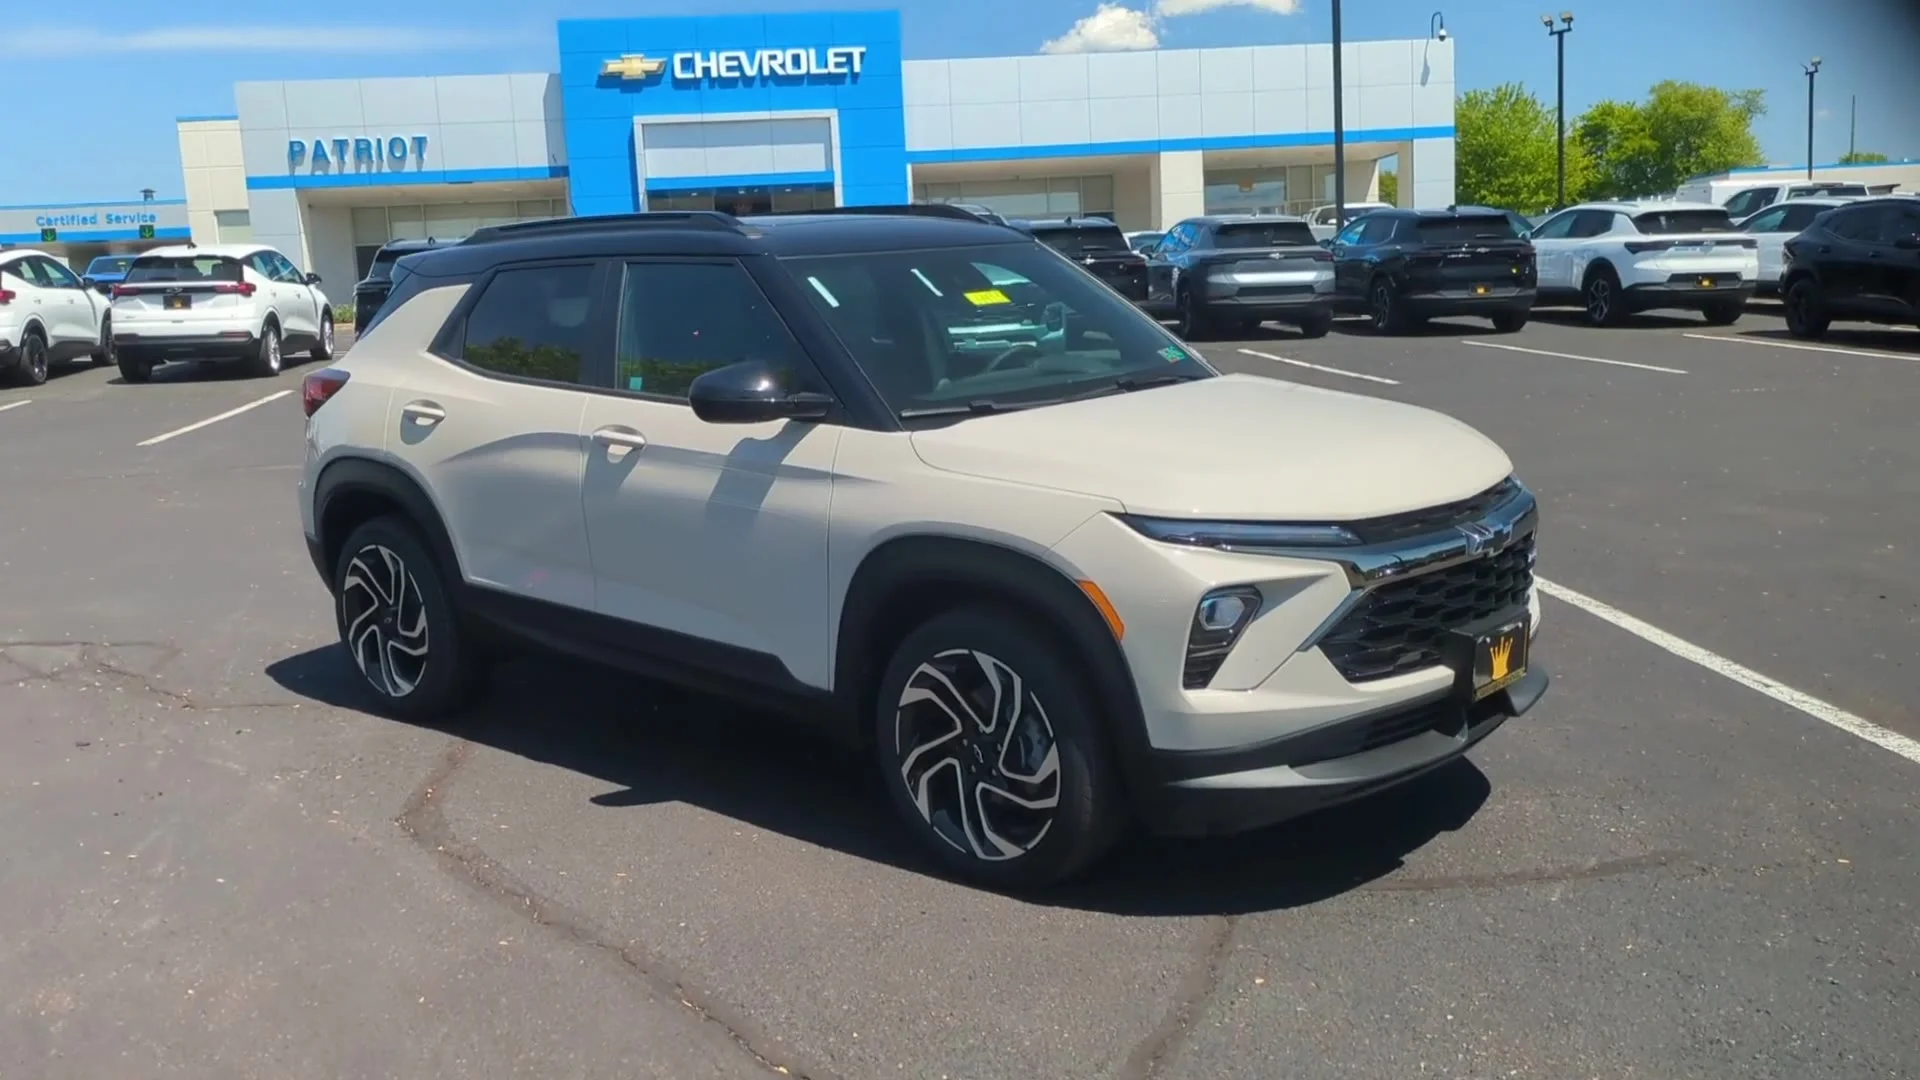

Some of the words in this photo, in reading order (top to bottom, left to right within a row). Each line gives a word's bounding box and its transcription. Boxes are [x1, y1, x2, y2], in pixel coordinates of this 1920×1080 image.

[673, 46, 867, 79] CHEVROLET
[288, 136, 429, 162] PATRIOT
[36, 213, 98, 226] Certified
[106, 212, 157, 224] Service
